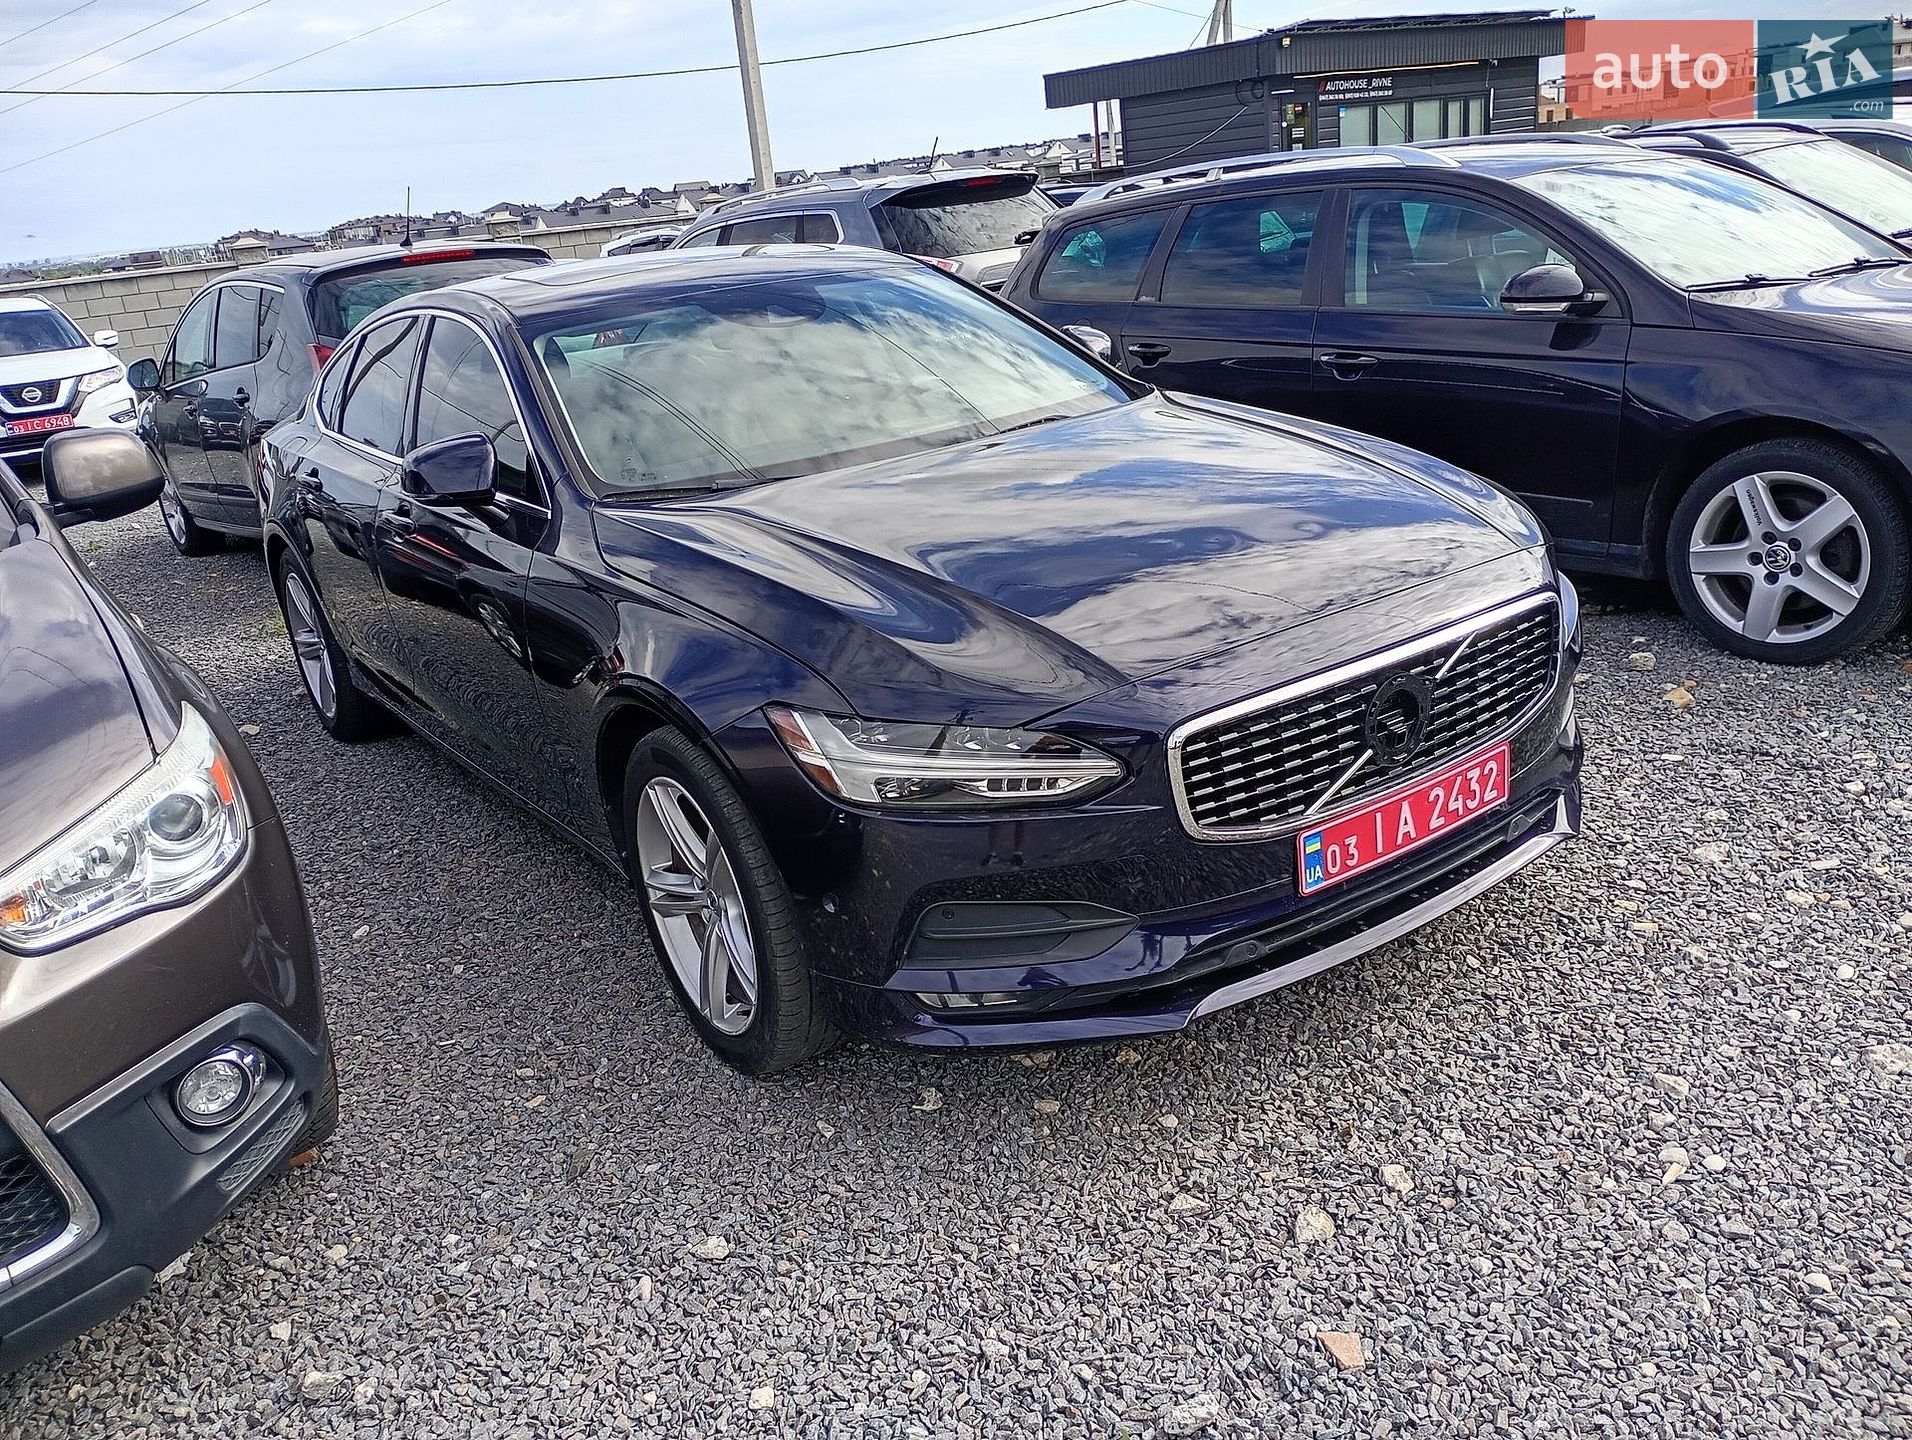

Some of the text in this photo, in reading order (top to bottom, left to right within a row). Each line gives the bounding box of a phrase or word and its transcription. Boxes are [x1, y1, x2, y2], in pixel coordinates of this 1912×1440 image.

[14, 425, 24, 433] 03
[44, 416, 70, 428] 6948
[1306, 760, 1499, 883] UA 03 IA 2432
